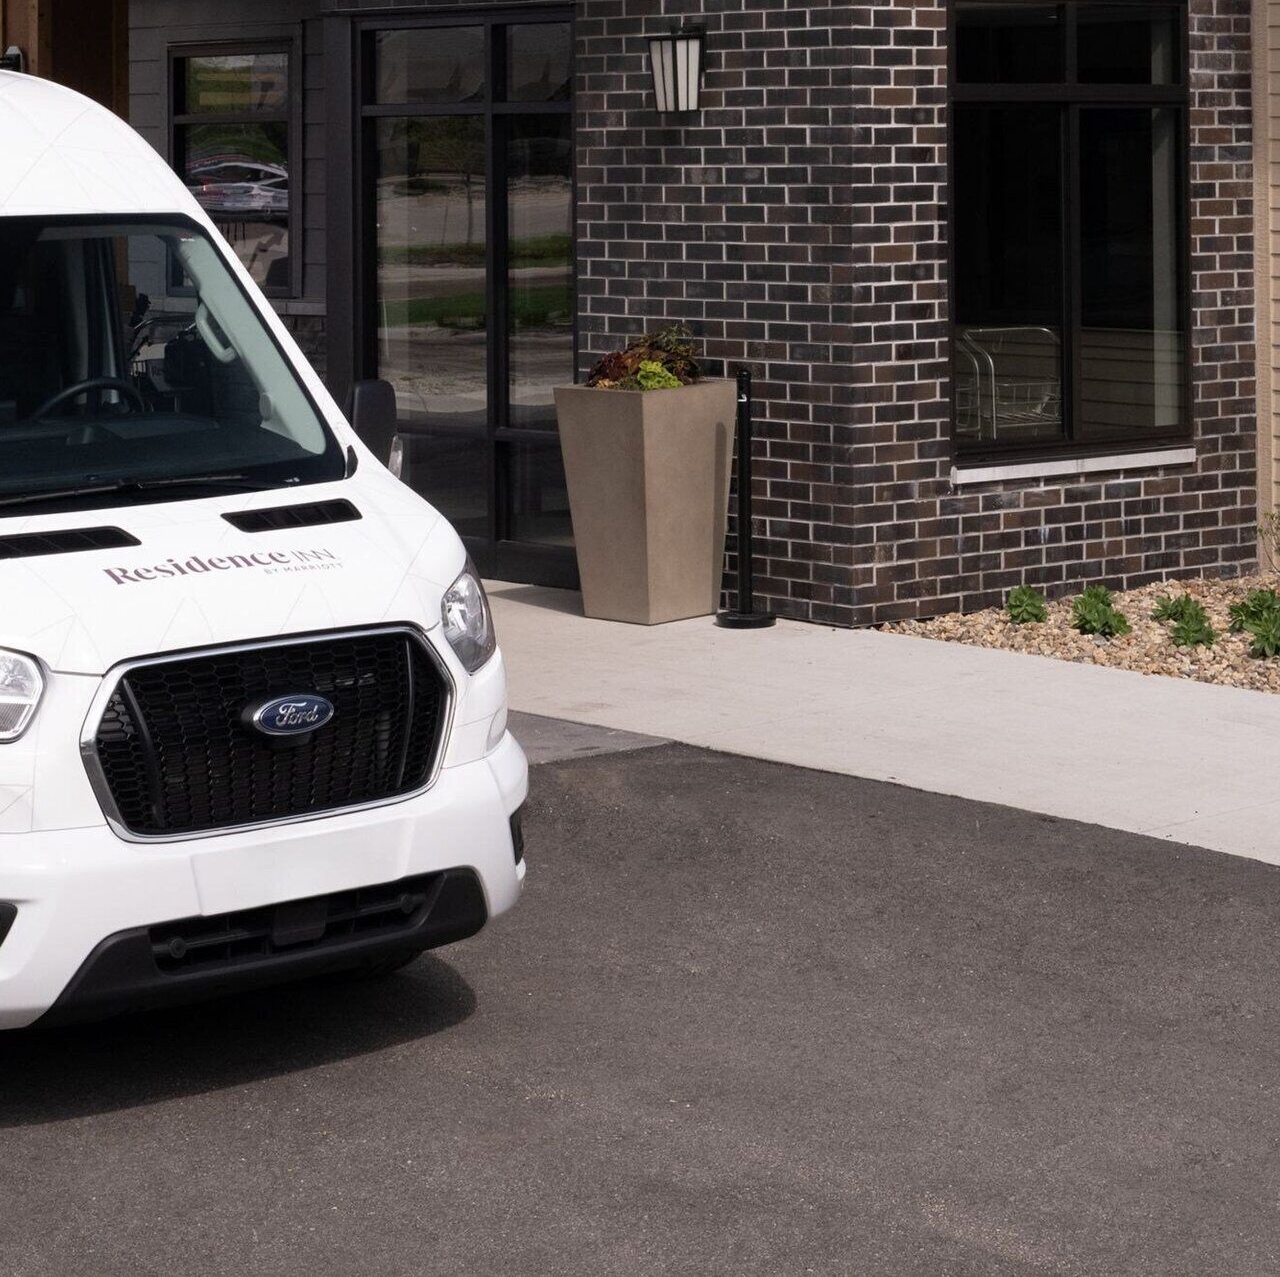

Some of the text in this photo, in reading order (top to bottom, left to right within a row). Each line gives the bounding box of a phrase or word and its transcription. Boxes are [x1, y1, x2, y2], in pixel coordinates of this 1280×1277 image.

[102, 548, 336, 585] Residence INN
[283, 562, 344, 572] MARRIOTT
[275, 701, 319, 727] Ford
